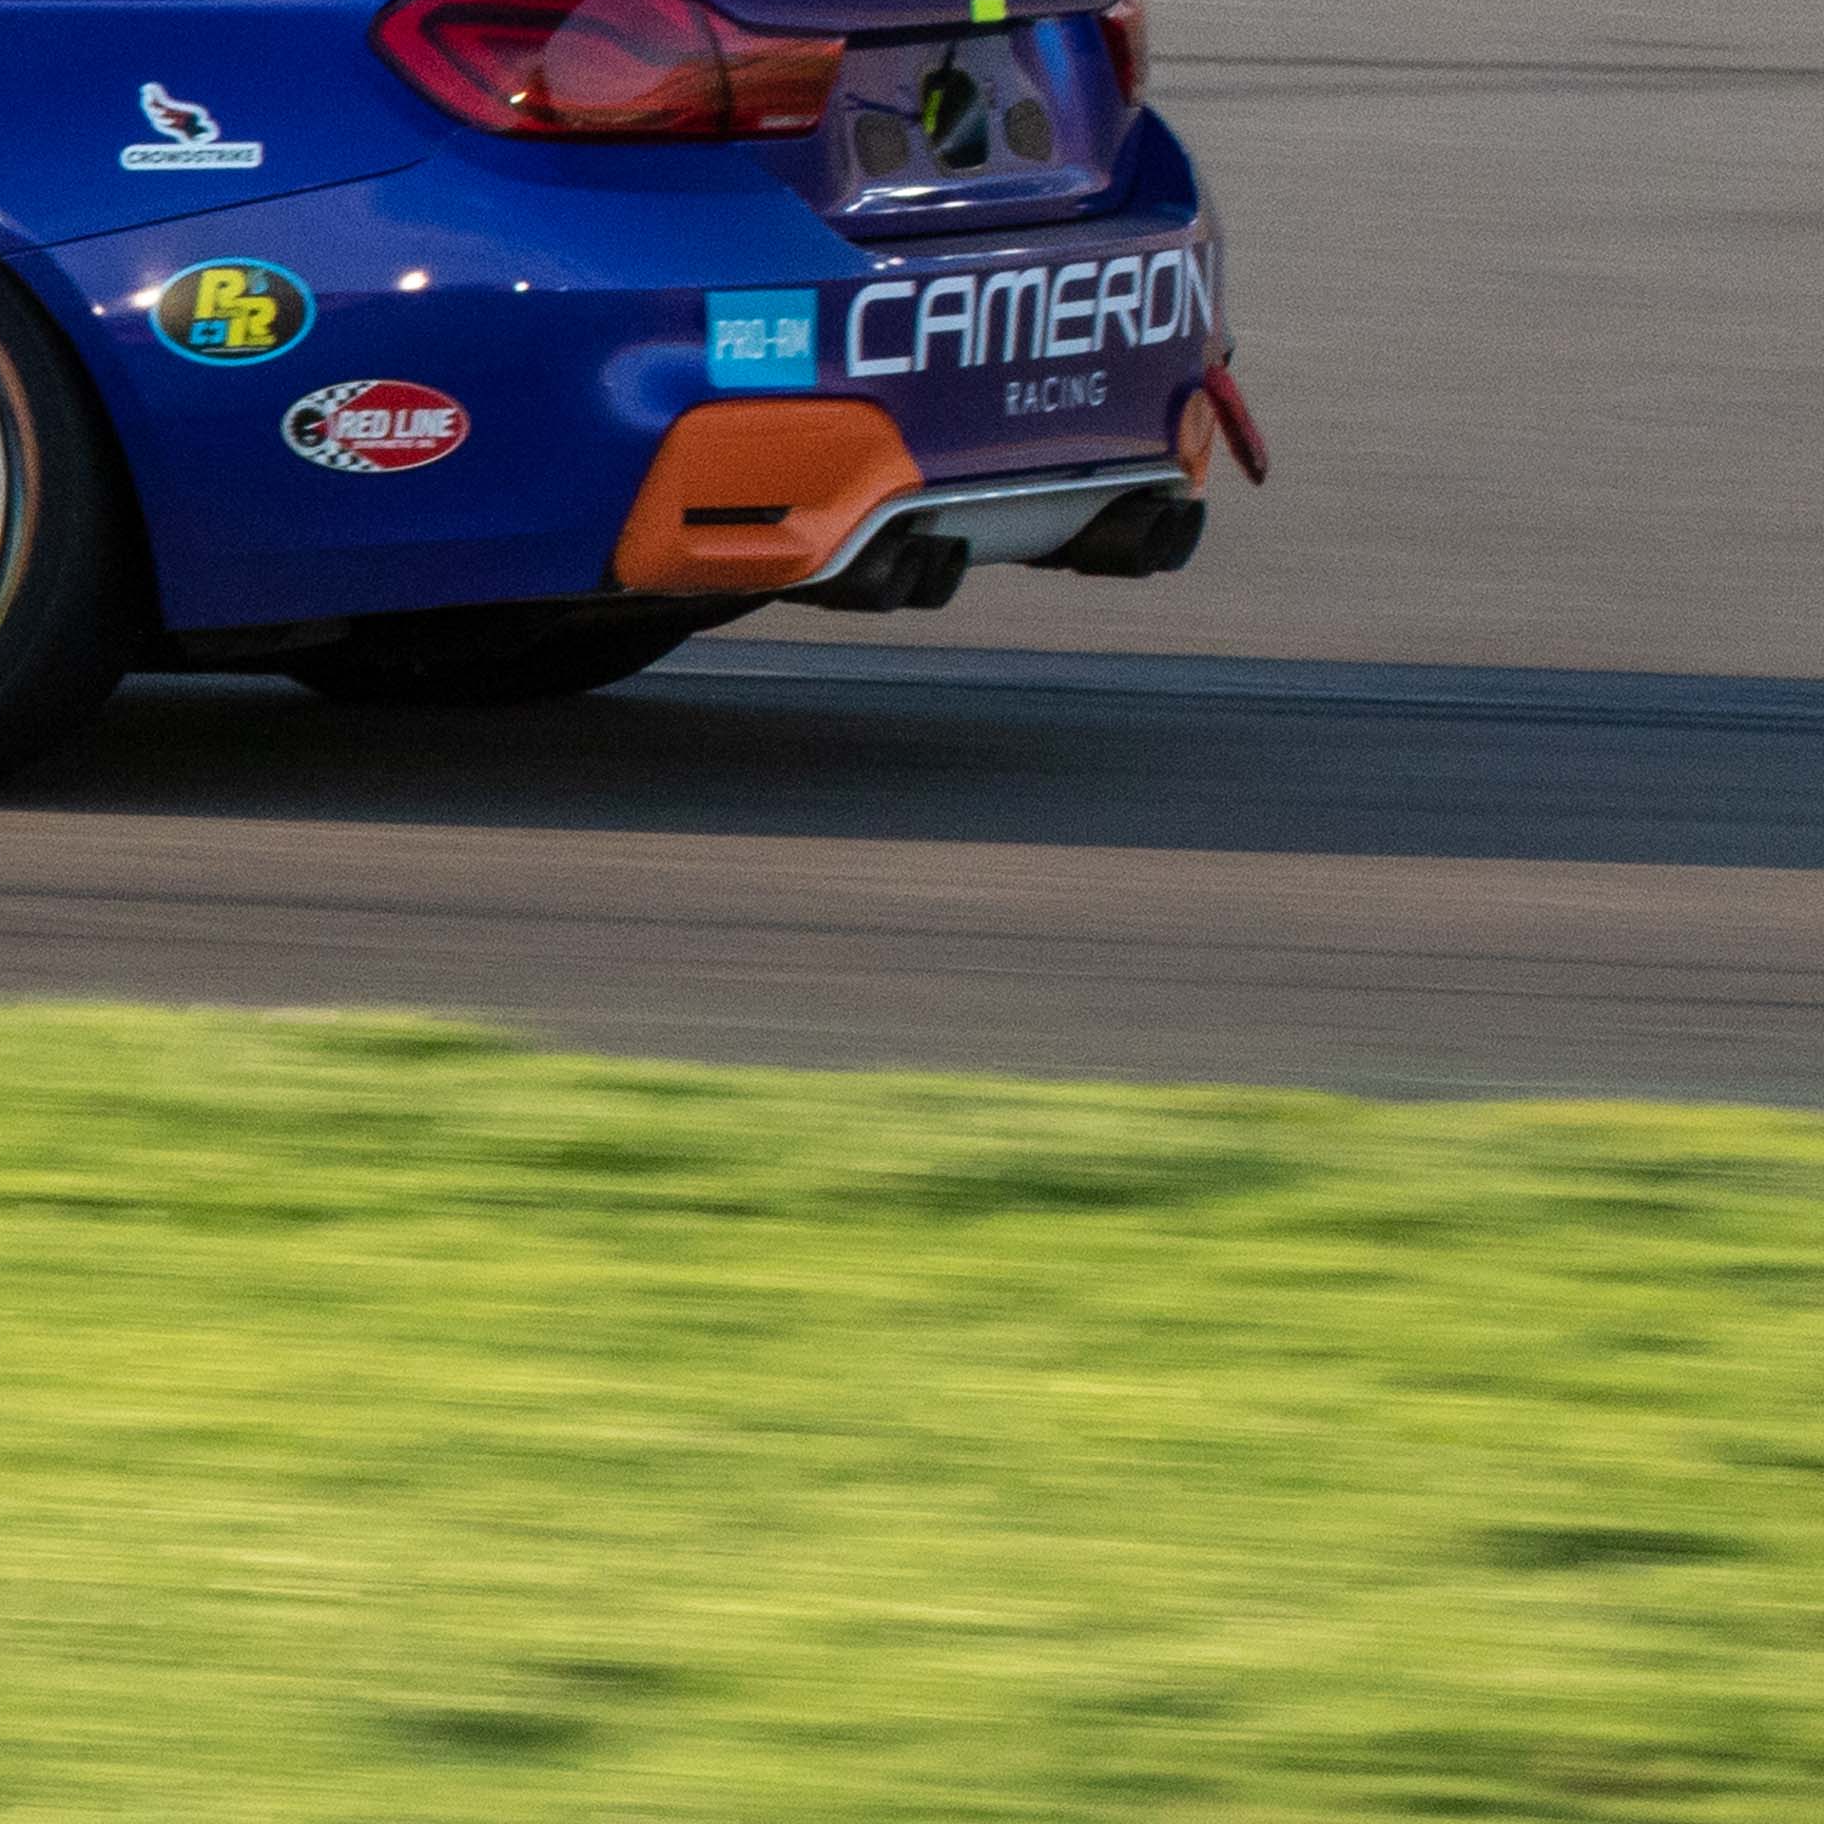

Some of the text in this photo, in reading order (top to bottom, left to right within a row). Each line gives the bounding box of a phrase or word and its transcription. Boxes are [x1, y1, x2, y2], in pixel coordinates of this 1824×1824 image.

[847, 242, 1215, 378] CAMERON
[1004, 374, 1108, 417] RACING
[336, 409, 457, 438] RED LINE
